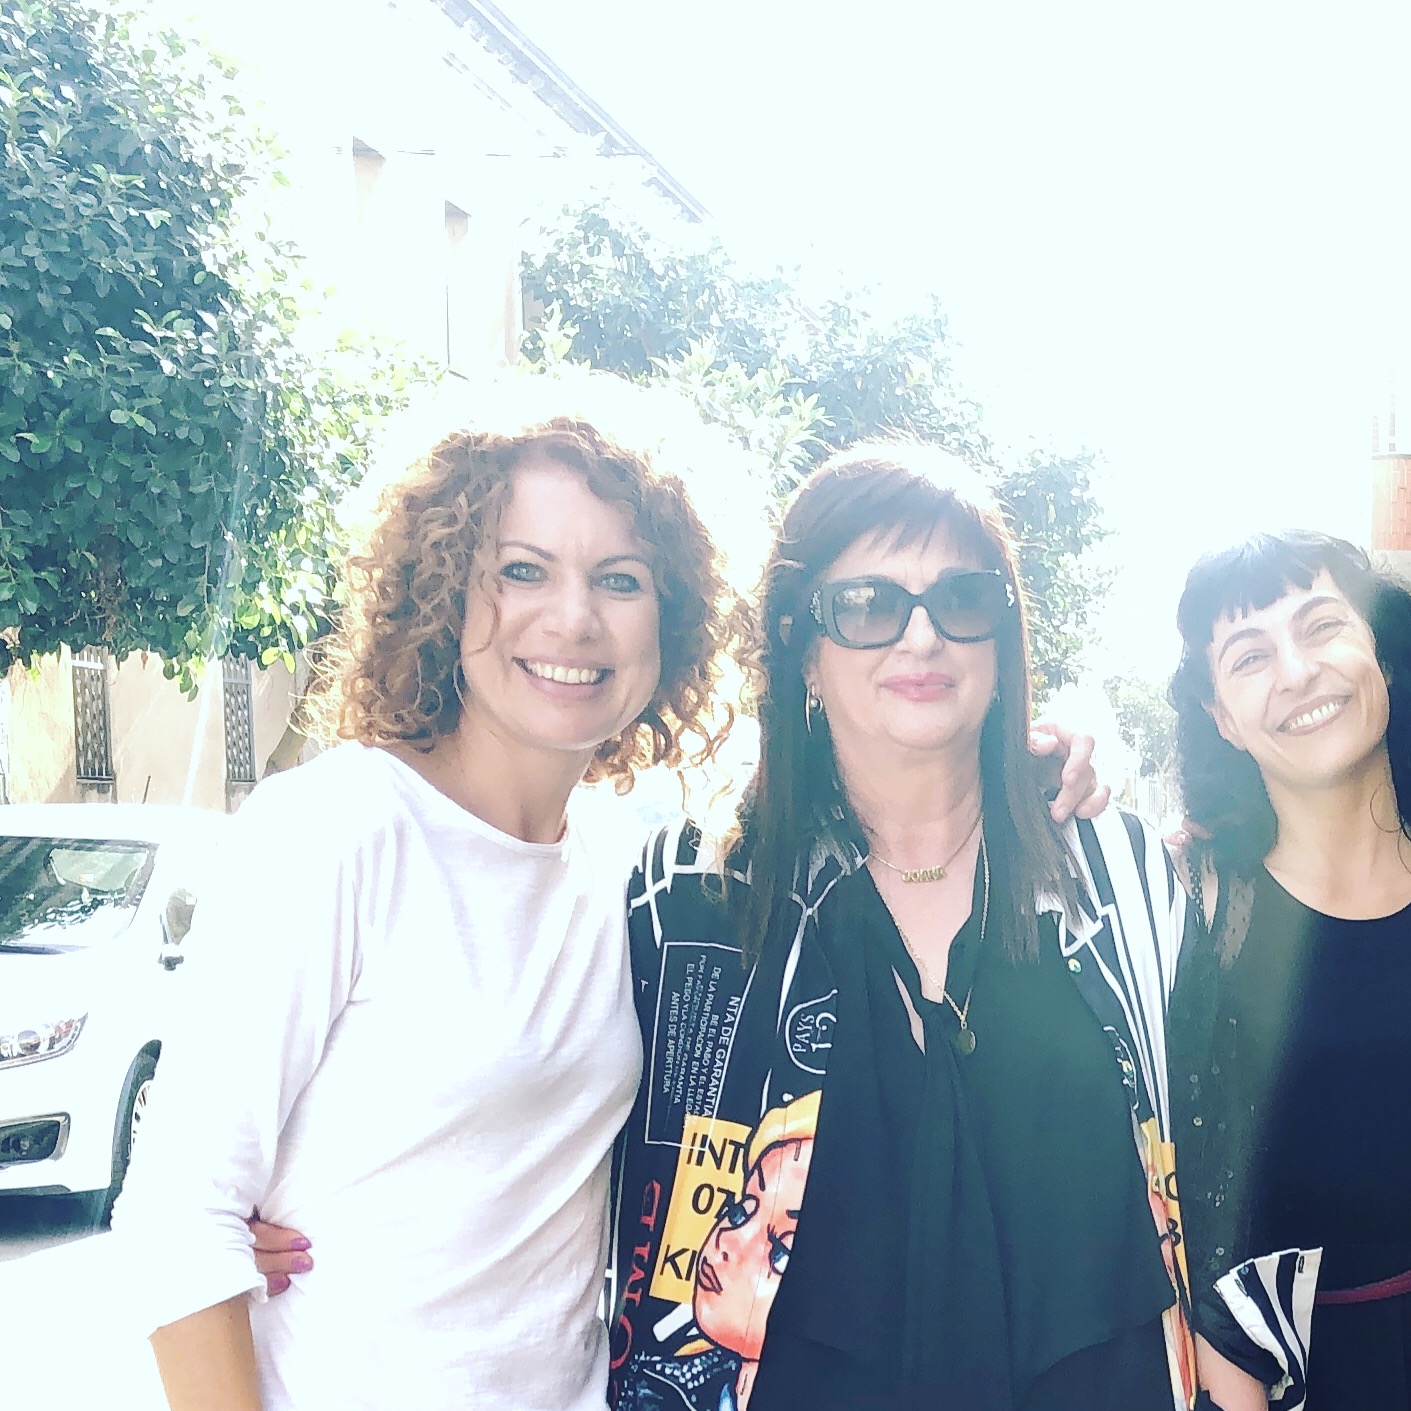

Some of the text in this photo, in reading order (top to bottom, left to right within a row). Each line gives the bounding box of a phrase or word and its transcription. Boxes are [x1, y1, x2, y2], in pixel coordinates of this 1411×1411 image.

[686, 963, 695, 975] EL
[711, 966, 722, 980] DE
[708, 980, 718, 992] LA
[669, 991, 681, 1022] ANTES
[667, 1024, 677, 1037] DE
[707, 1028, 717, 1039] EL
[719, 1026, 733, 1046] DE
[792, 1013, 815, 1053] PAYS
[690, 1061, 700, 1074] EN
[688, 1075, 698, 1087] LA
[698, 1075, 707, 1085] EL
[702, 1048, 726, 1117] GARANTIA
